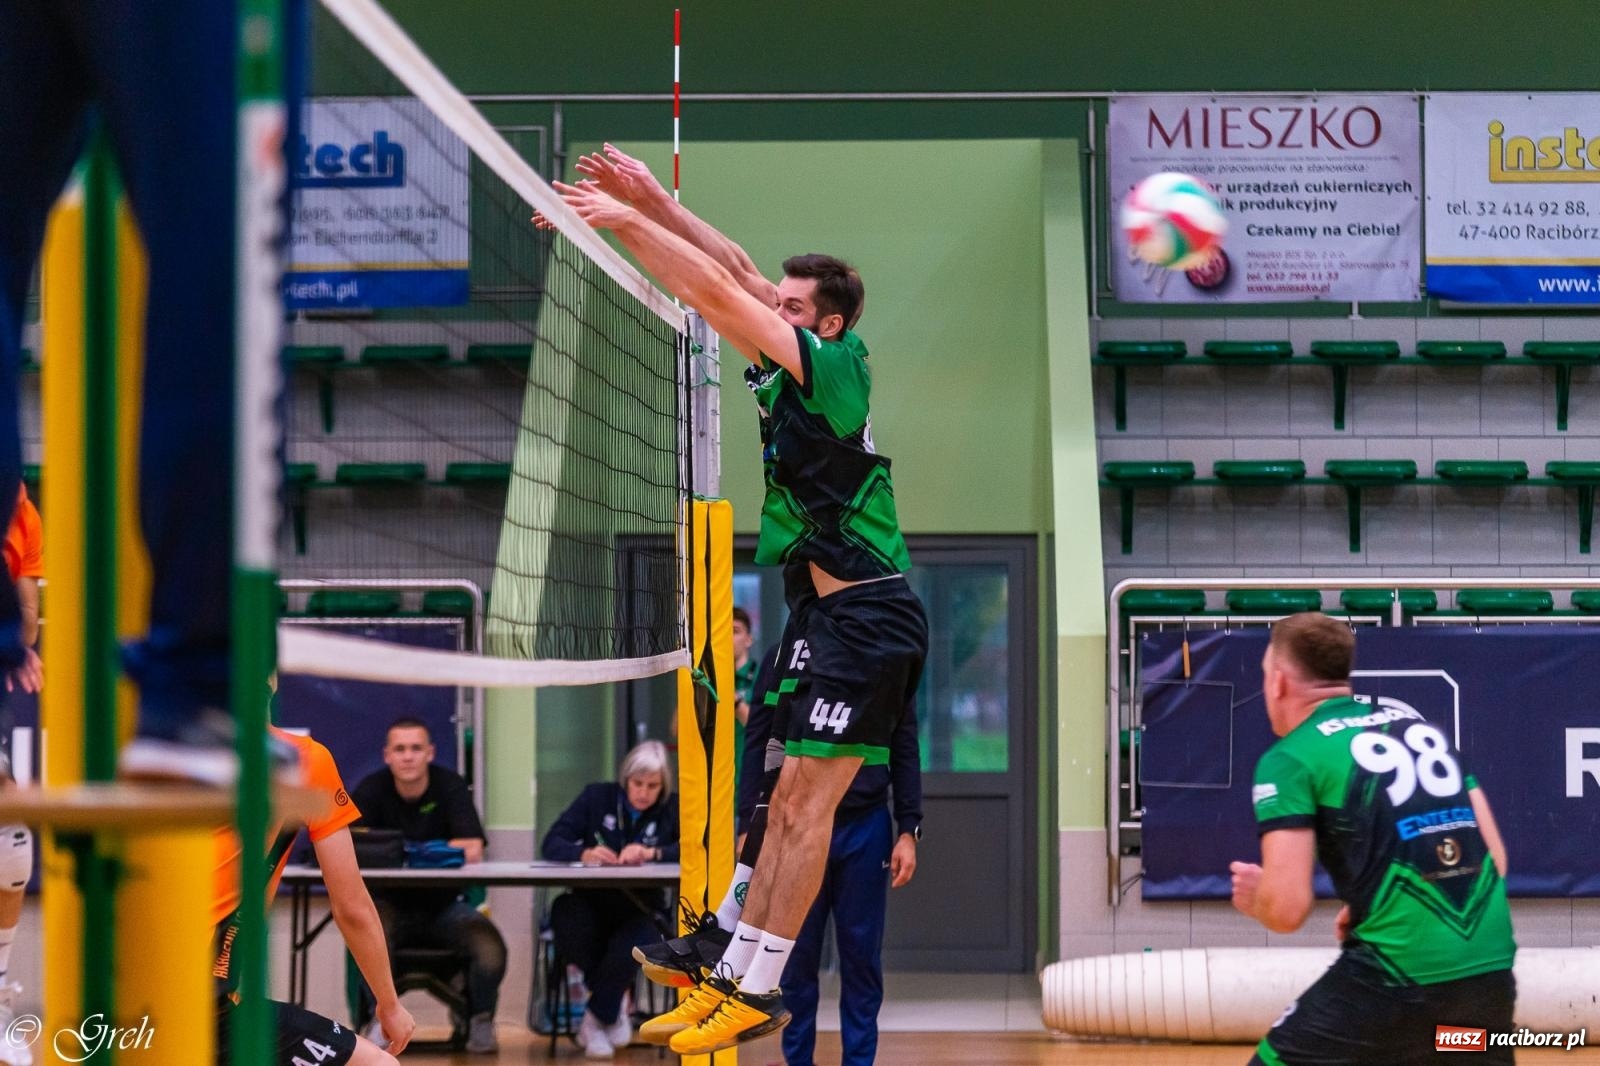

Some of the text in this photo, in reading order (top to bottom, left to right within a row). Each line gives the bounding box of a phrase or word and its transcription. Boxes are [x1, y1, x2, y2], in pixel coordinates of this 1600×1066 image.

[1147, 105, 1383, 150] MIESZKO
[1227, 180, 1300, 195] urządzeń
[1304, 180, 1413, 195] cukierniczych
[1239, 198, 1338, 212] produkcyjny
[1446, 200, 1590, 217] tel. 32 414 92 88,
[1246, 223, 1317, 238] Czekamy
[1323, 226, 1342, 236] na
[1459, 225, 1520, 240] 47-400
[809, 697, 852, 735] 44
[1350, 722, 1463, 808] 98
